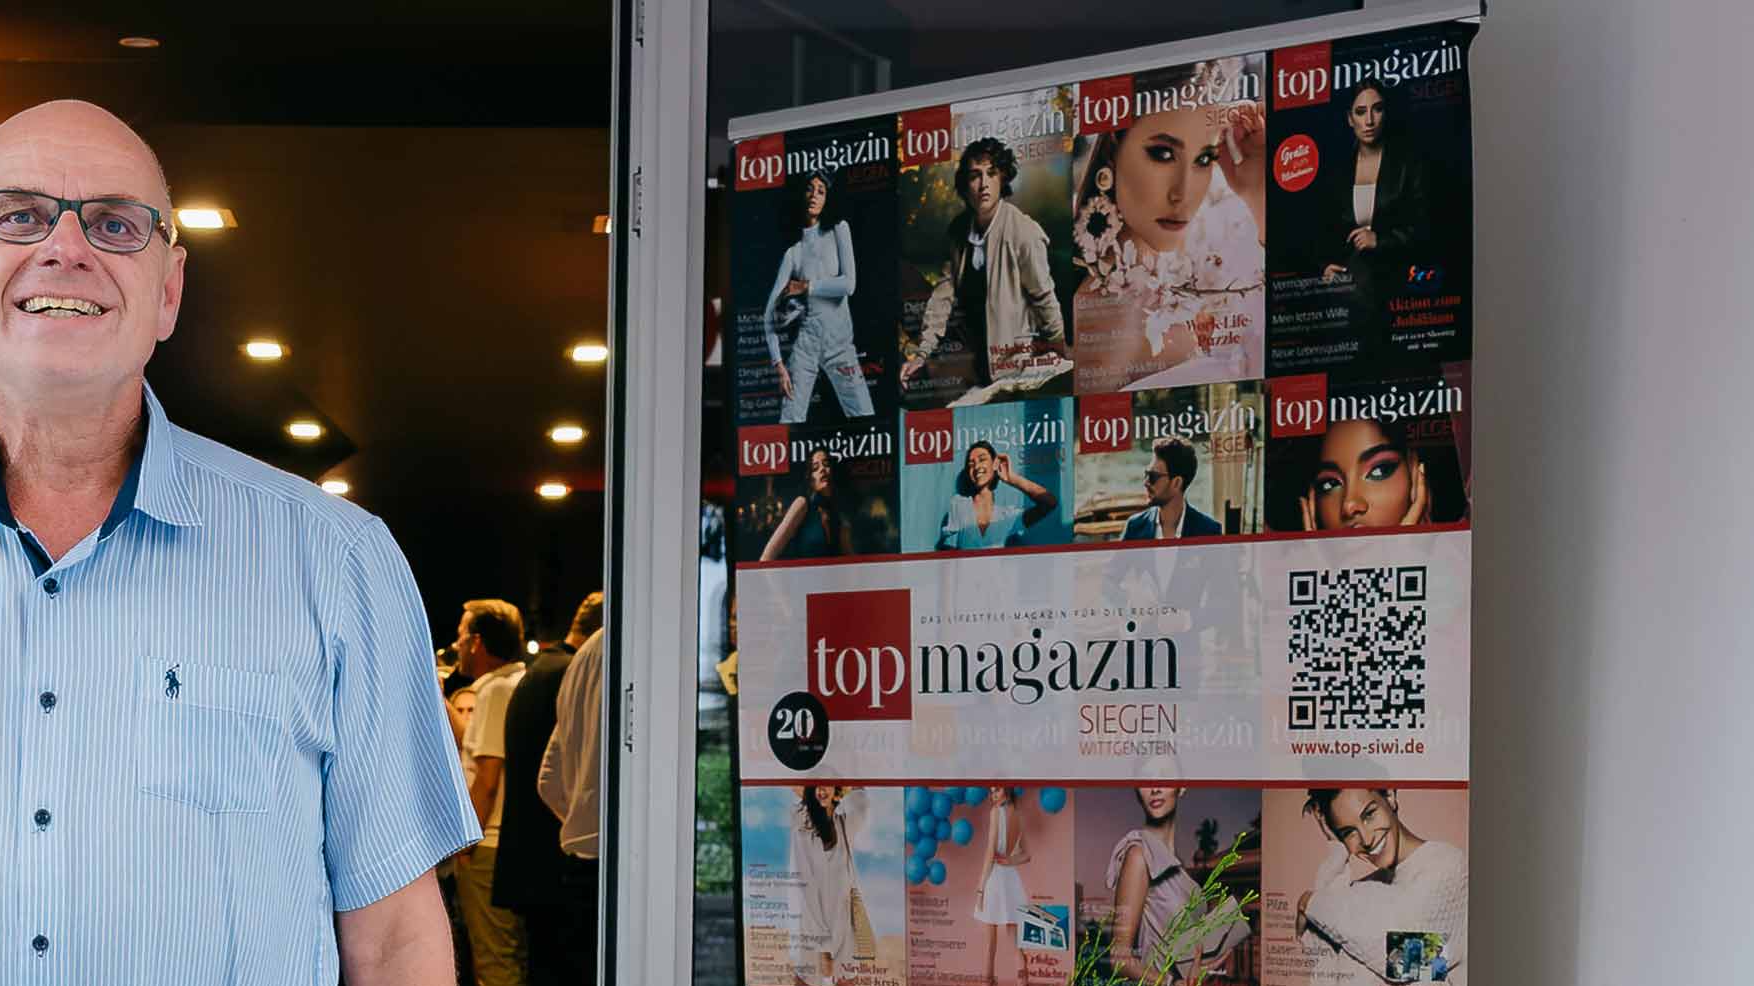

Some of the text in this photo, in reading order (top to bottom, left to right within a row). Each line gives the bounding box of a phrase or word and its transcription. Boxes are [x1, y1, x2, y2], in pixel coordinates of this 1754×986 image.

[1277, 40, 1461, 100] top magazin
[1084, 72, 1261, 125] top magazin
[739, 131, 891, 183] top magazin
[907, 127, 950, 159] top
[1084, 399, 1257, 447] top magazin
[1275, 380, 1462, 431] top magazin
[744, 439, 786, 469] top
[909, 414, 1066, 458] top magazin
[814, 621, 1181, 708] top magazin
[776, 708, 814, 740] 20
[1079, 703, 1177, 735] SIEGEN
[1079, 740, 1177, 756] WITTGENSTEIN
[1291, 738, 1425, 758] www.top-siwi.de
